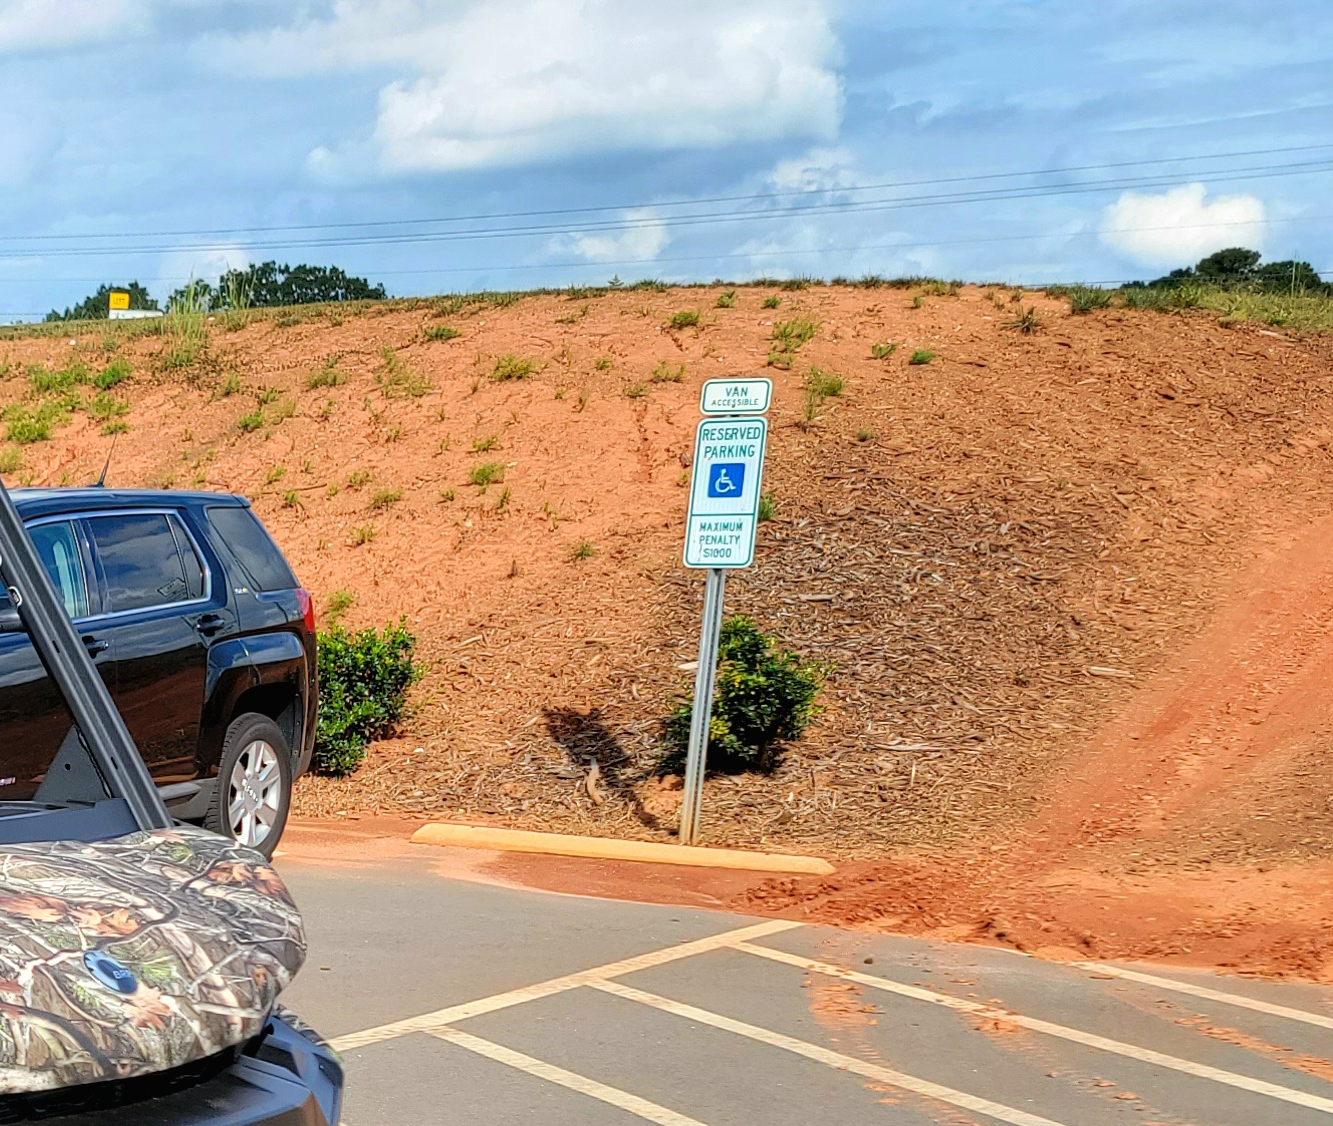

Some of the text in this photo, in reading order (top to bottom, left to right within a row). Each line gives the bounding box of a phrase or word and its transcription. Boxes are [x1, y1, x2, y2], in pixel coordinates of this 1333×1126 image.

[726, 386, 748, 397] VAN
[711, 398, 759, 407] ACCESSIBLE
[702, 426, 761, 441] RESERVED
[703, 444, 756, 459] PARKING
[699, 521, 743, 531] MAXIMUM
[699, 535, 740, 545] PENALTY
